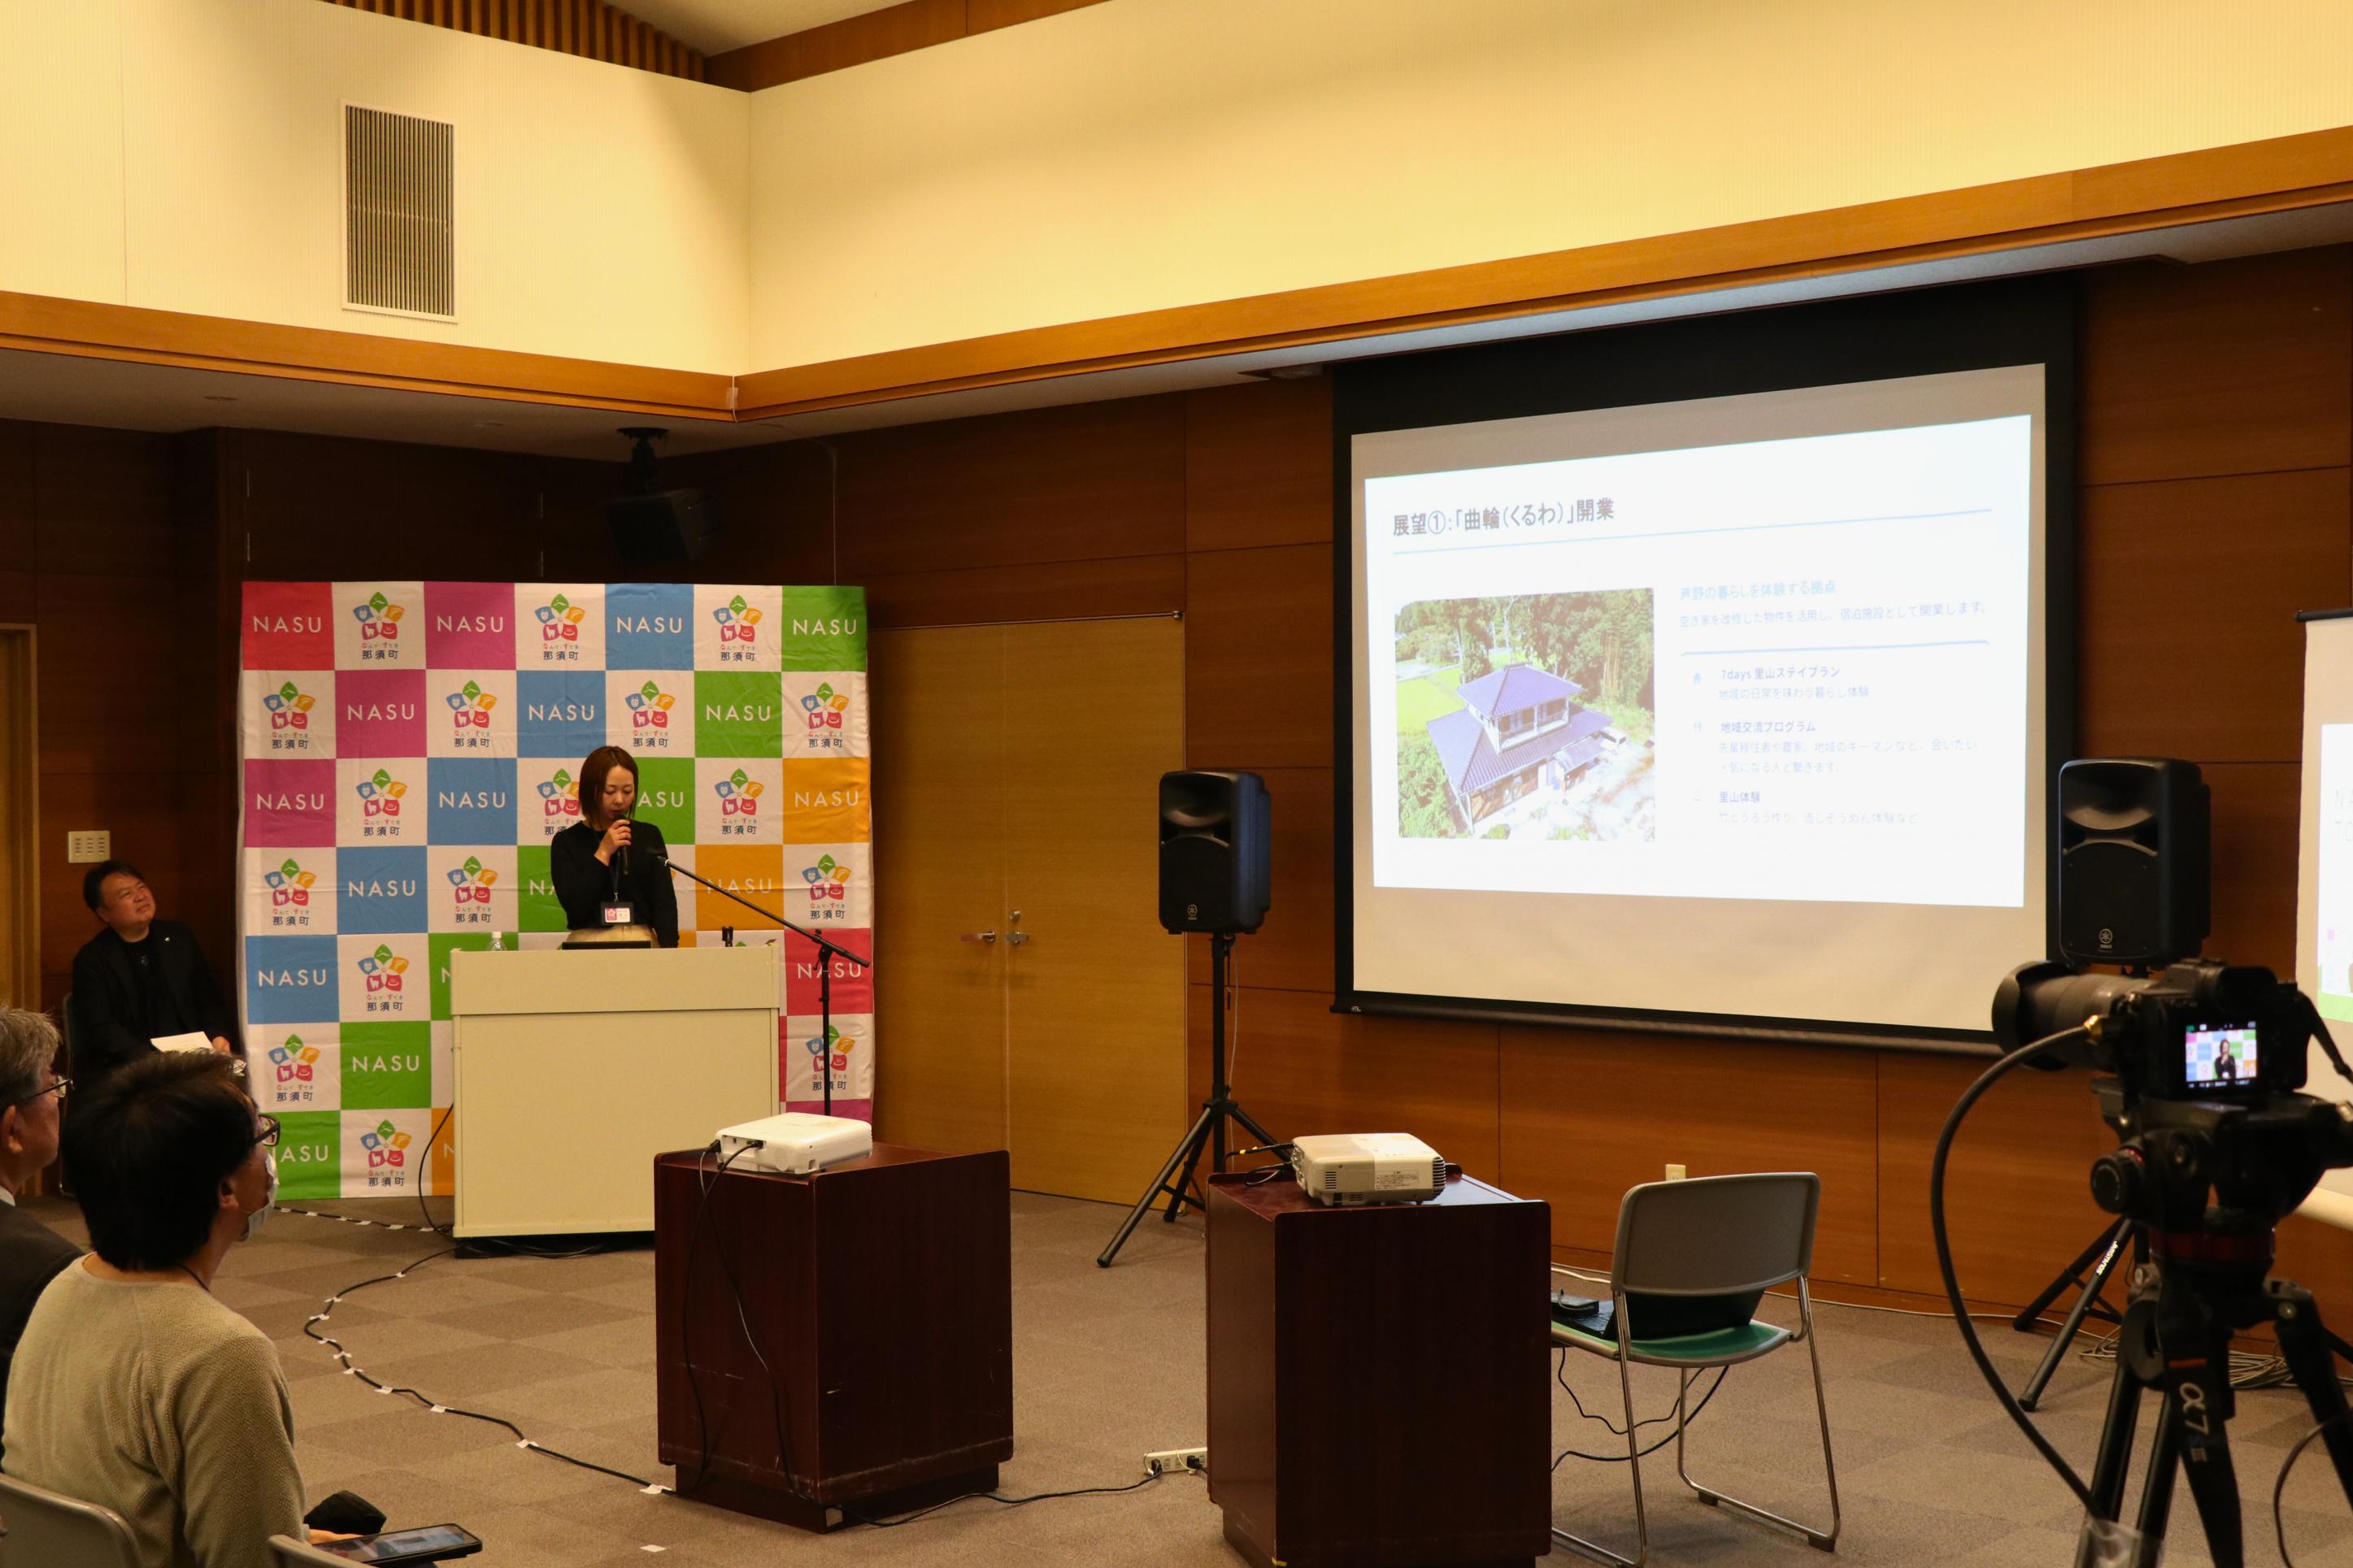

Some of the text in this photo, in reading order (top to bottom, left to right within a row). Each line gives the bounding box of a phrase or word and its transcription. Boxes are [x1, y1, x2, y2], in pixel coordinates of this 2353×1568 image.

[253, 616, 322, 633] NASU
[437, 615, 504, 633] NASU
[616, 616, 683, 634] NASU
[793, 619, 857, 636] NASU
[362, 650, 398, 660] 那須町
[543, 651, 579, 661] 那須町
[720, 652, 755, 662] 那須町
[1720, 668, 1751, 681] 7days
[347, 704, 415, 721] NASU
[528, 704, 594, 722] NASU
[706, 705, 771, 722] NASU
[272, 740, 308, 749] 那須町
[454, 738, 490, 748] 那須町
[633, 737, 668, 748] 那須町
[808, 738, 842, 749] 那須町
[256, 793, 324, 810] NASU
[438, 792, 507, 809] NASU
[637, 791, 684, 808] ASU
[794, 791, 859, 808] NASU
[363, 827, 400, 836] 那須町
[722, 825, 758, 835] 那須町
[349, 880, 417, 897] NASU
[455, 913, 491, 923] 那須町
[810, 910, 846, 919] 那須町
[272, 916, 309, 926] 那須町
[259, 970, 327, 987] NASU
[367, 1001, 403, 1011] 那須町
[353, 1055, 420, 1073] NASU
[276, 1092, 313, 1101] 那須町
[368, 1177, 405, 1187] 那須町
